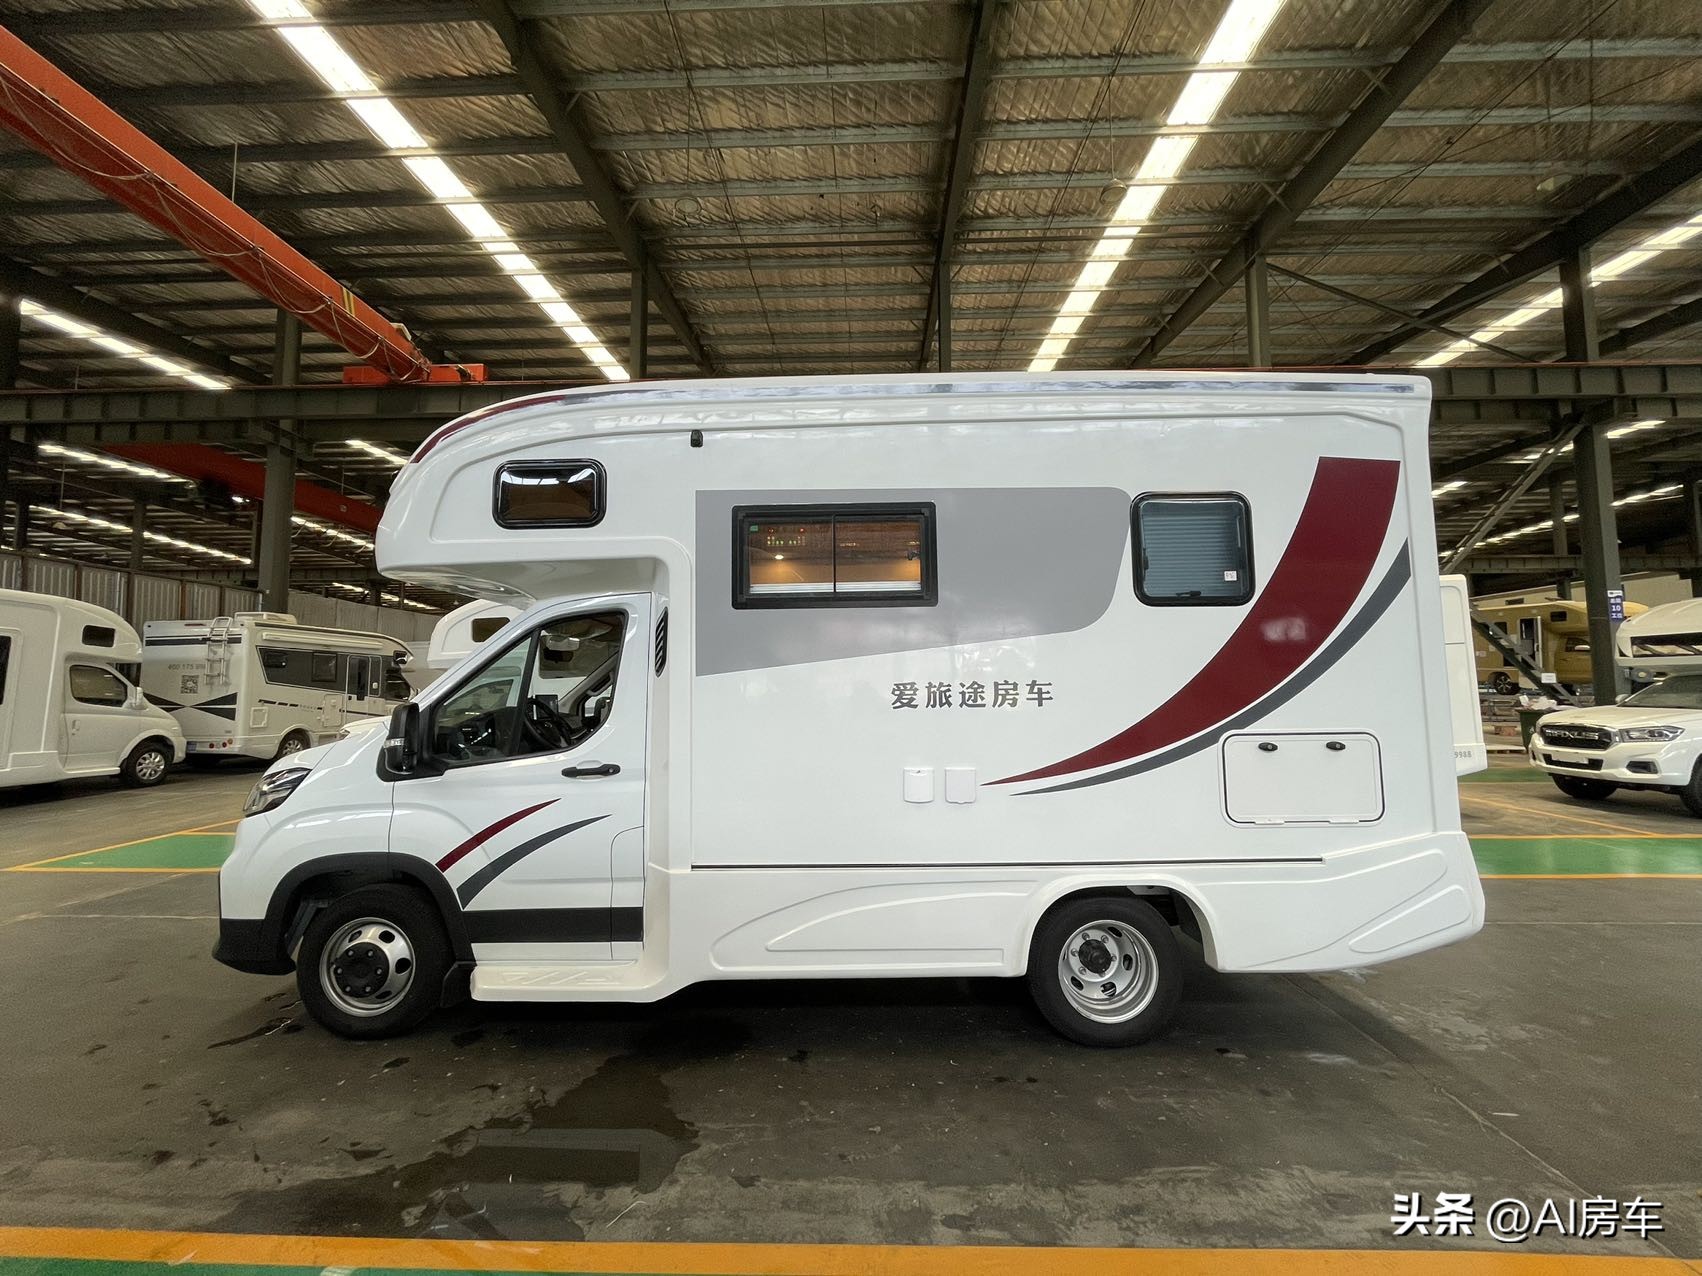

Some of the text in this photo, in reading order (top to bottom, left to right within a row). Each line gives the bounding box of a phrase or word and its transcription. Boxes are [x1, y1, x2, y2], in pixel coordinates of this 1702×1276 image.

[891, 679, 1054, 710] 爱旅途房车
